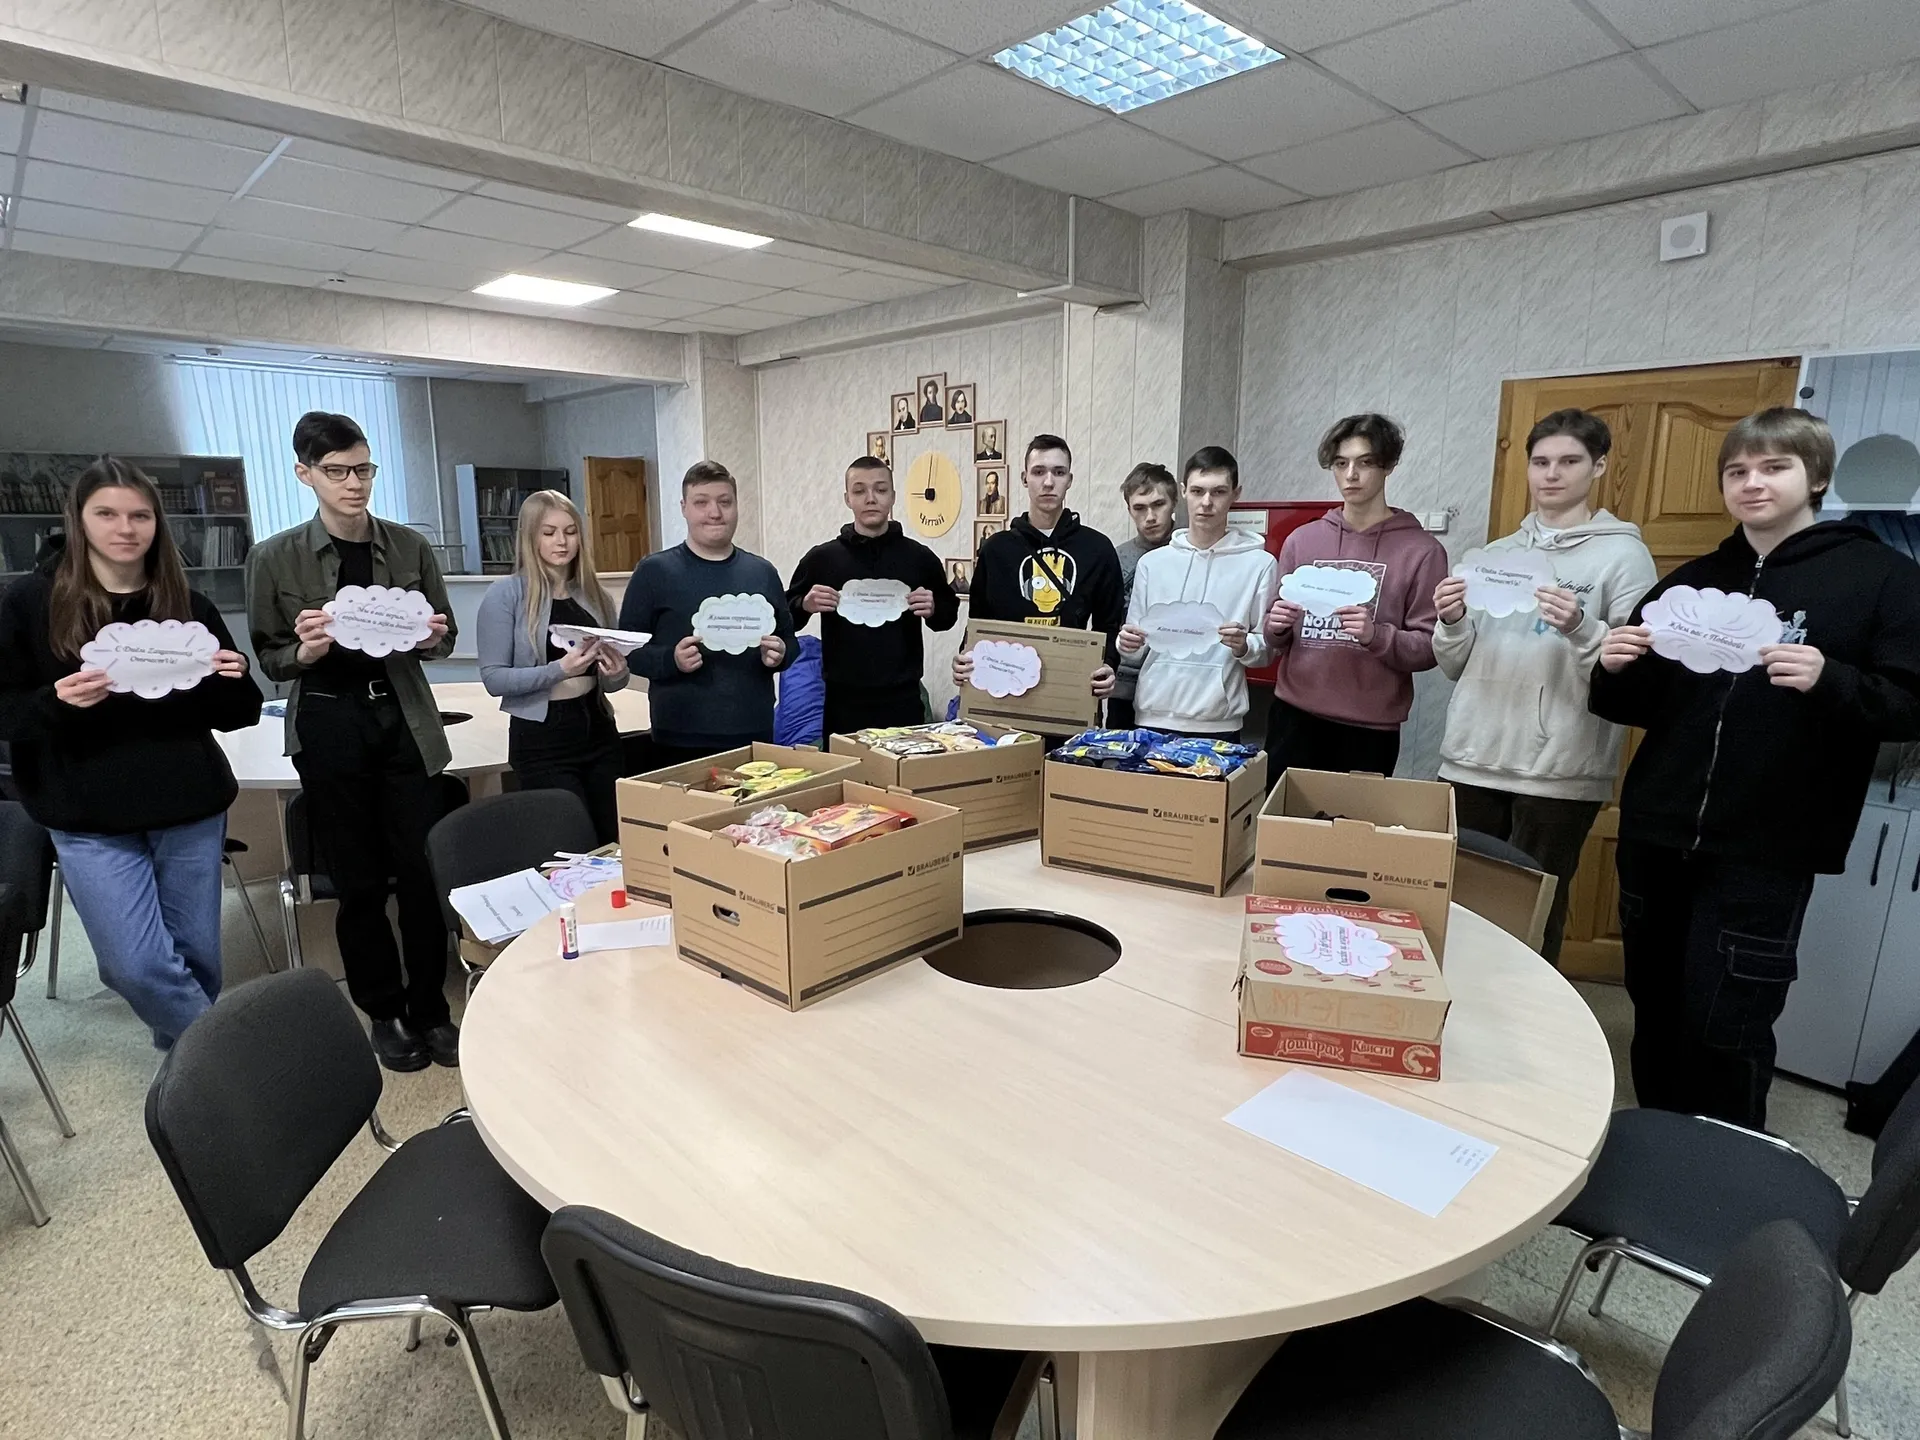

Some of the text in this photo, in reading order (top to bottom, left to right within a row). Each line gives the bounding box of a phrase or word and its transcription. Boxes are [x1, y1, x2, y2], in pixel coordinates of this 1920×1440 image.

[919, 512, 945, 526] Читай
[1555, 577, 1595, 595] idnight
[1303, 613, 1325, 628] NOT
[1709, 633, 1745, 650] Победой!
[1003, 771, 1032, 781] BRAUBERG
[1163, 810, 1205, 823] BRAUBERG
[916, 854, 950, 873] BRAUBERG
[1384, 874, 1429, 886] BRAUBERG
[746, 894, 775, 910] BRAUBERG
[1274, 1037, 1344, 1062] Доширак
[1351, 1039, 1395, 1058] Квисти
